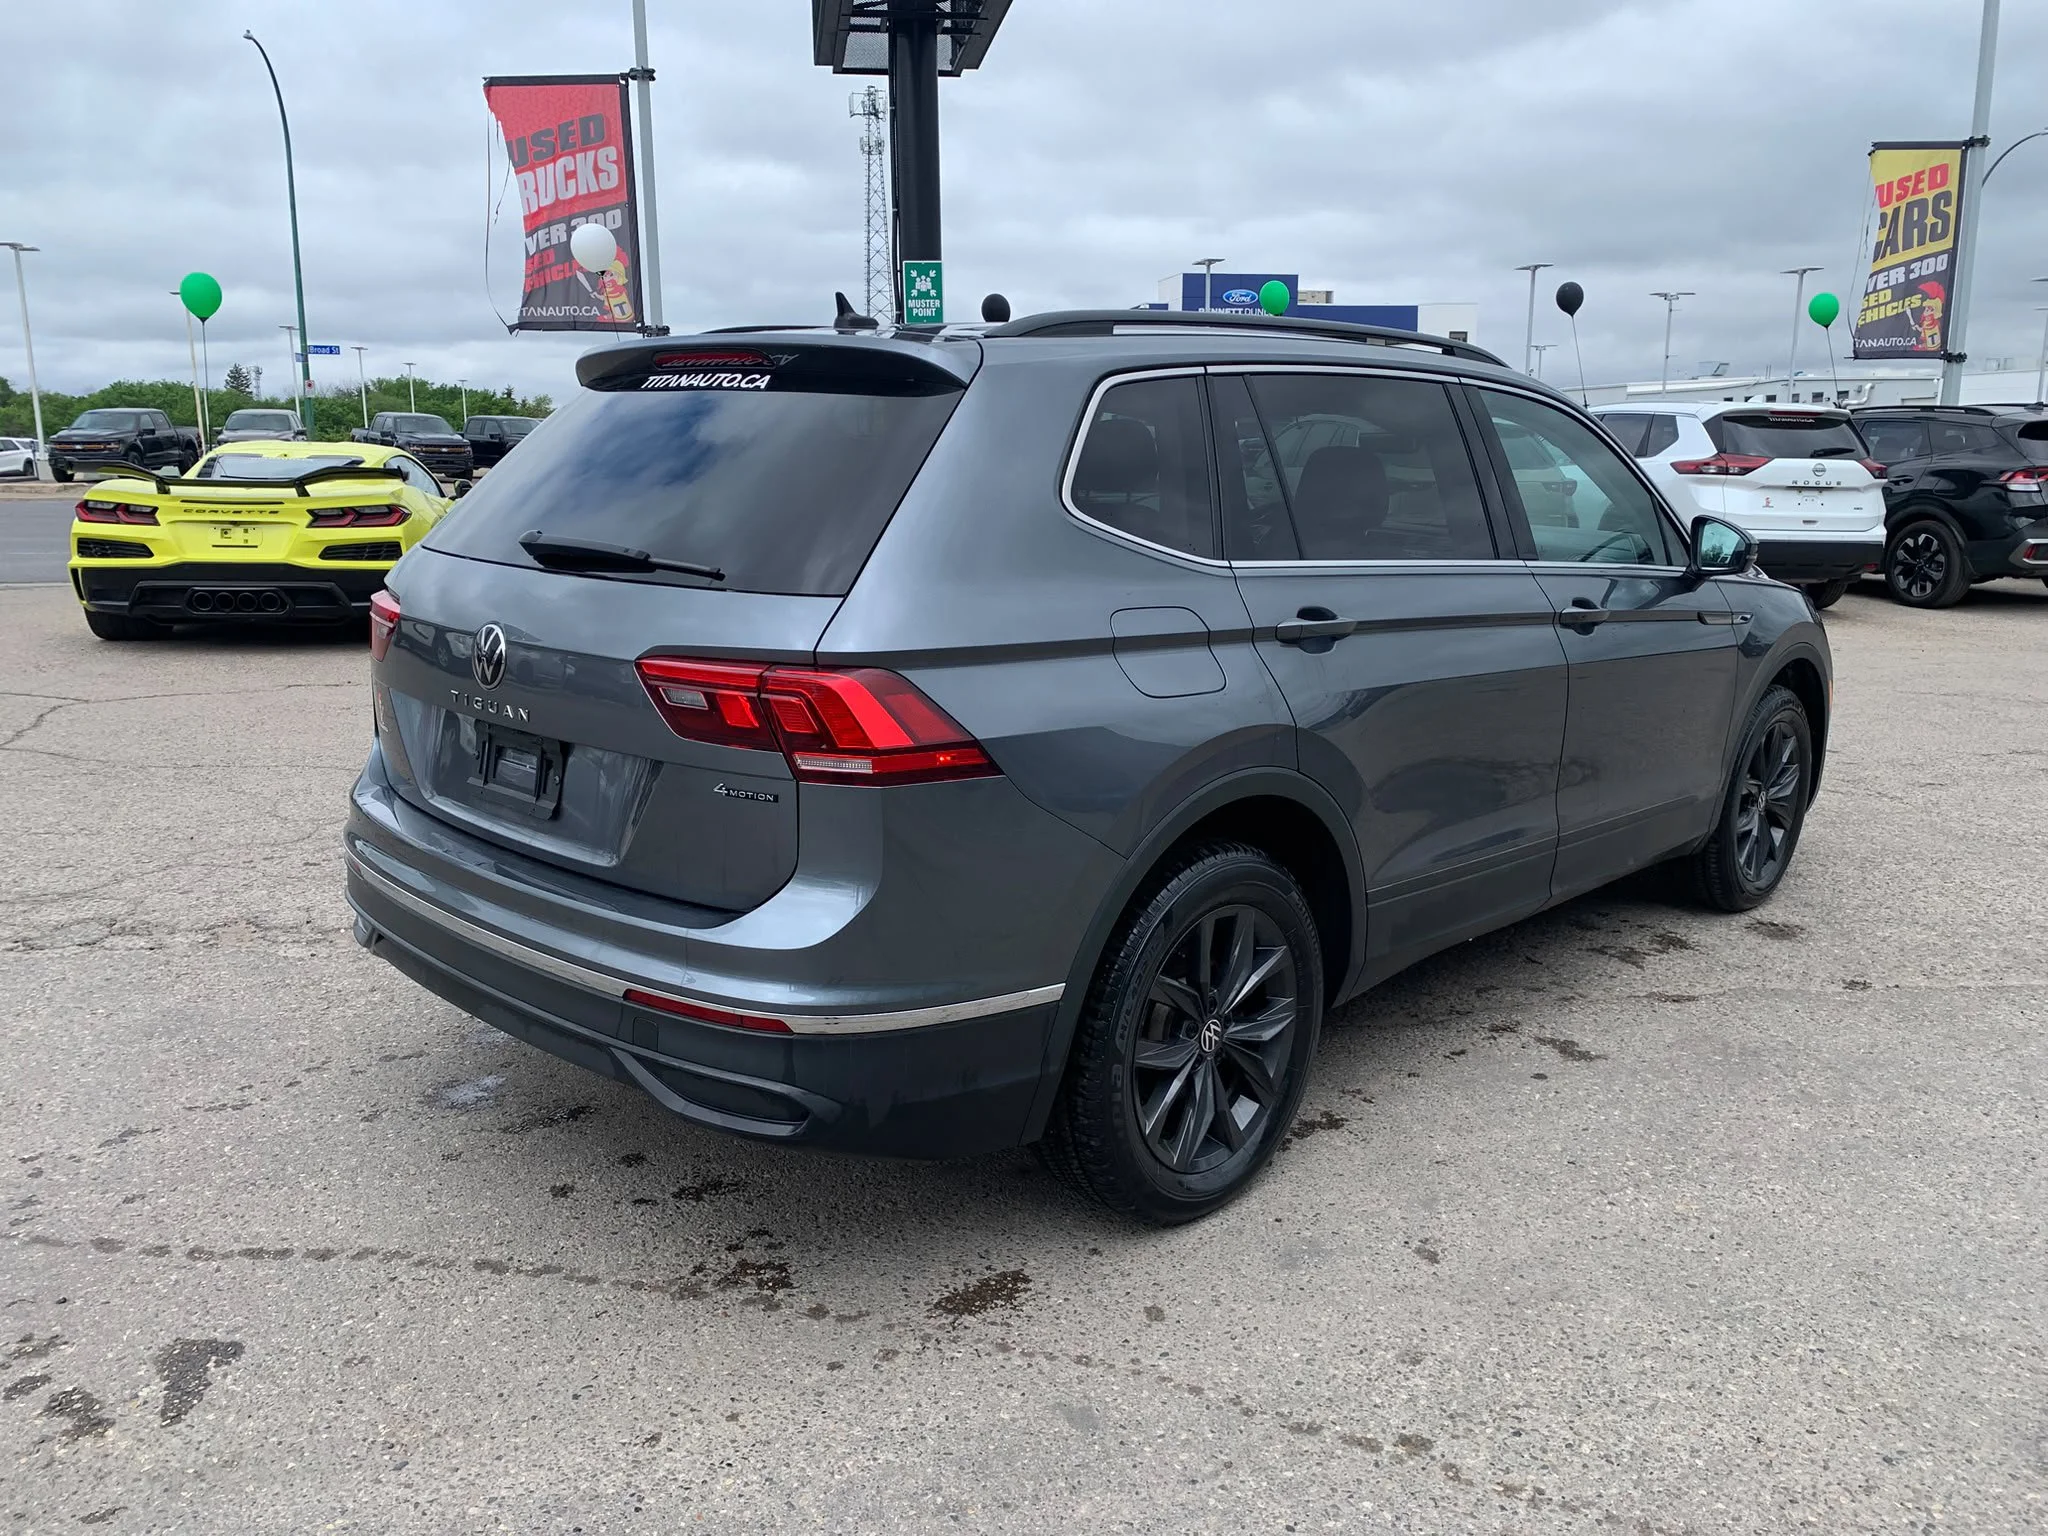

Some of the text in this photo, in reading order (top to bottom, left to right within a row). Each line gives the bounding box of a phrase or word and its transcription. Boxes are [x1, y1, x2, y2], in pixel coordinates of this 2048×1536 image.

[506, 113, 605, 169] USED
[1875, 163, 1949, 209] USED
[1909, 254, 1948, 280] 300
[908, 299, 941, 308] MUSTER
[1229, 290, 1252, 302] Ford
[912, 308, 936, 317] POINT
[309, 345, 330, 354] Broad
[641, 373, 771, 389] TITANAUTO.CA
[450, 690, 530, 722] TIGUAN
